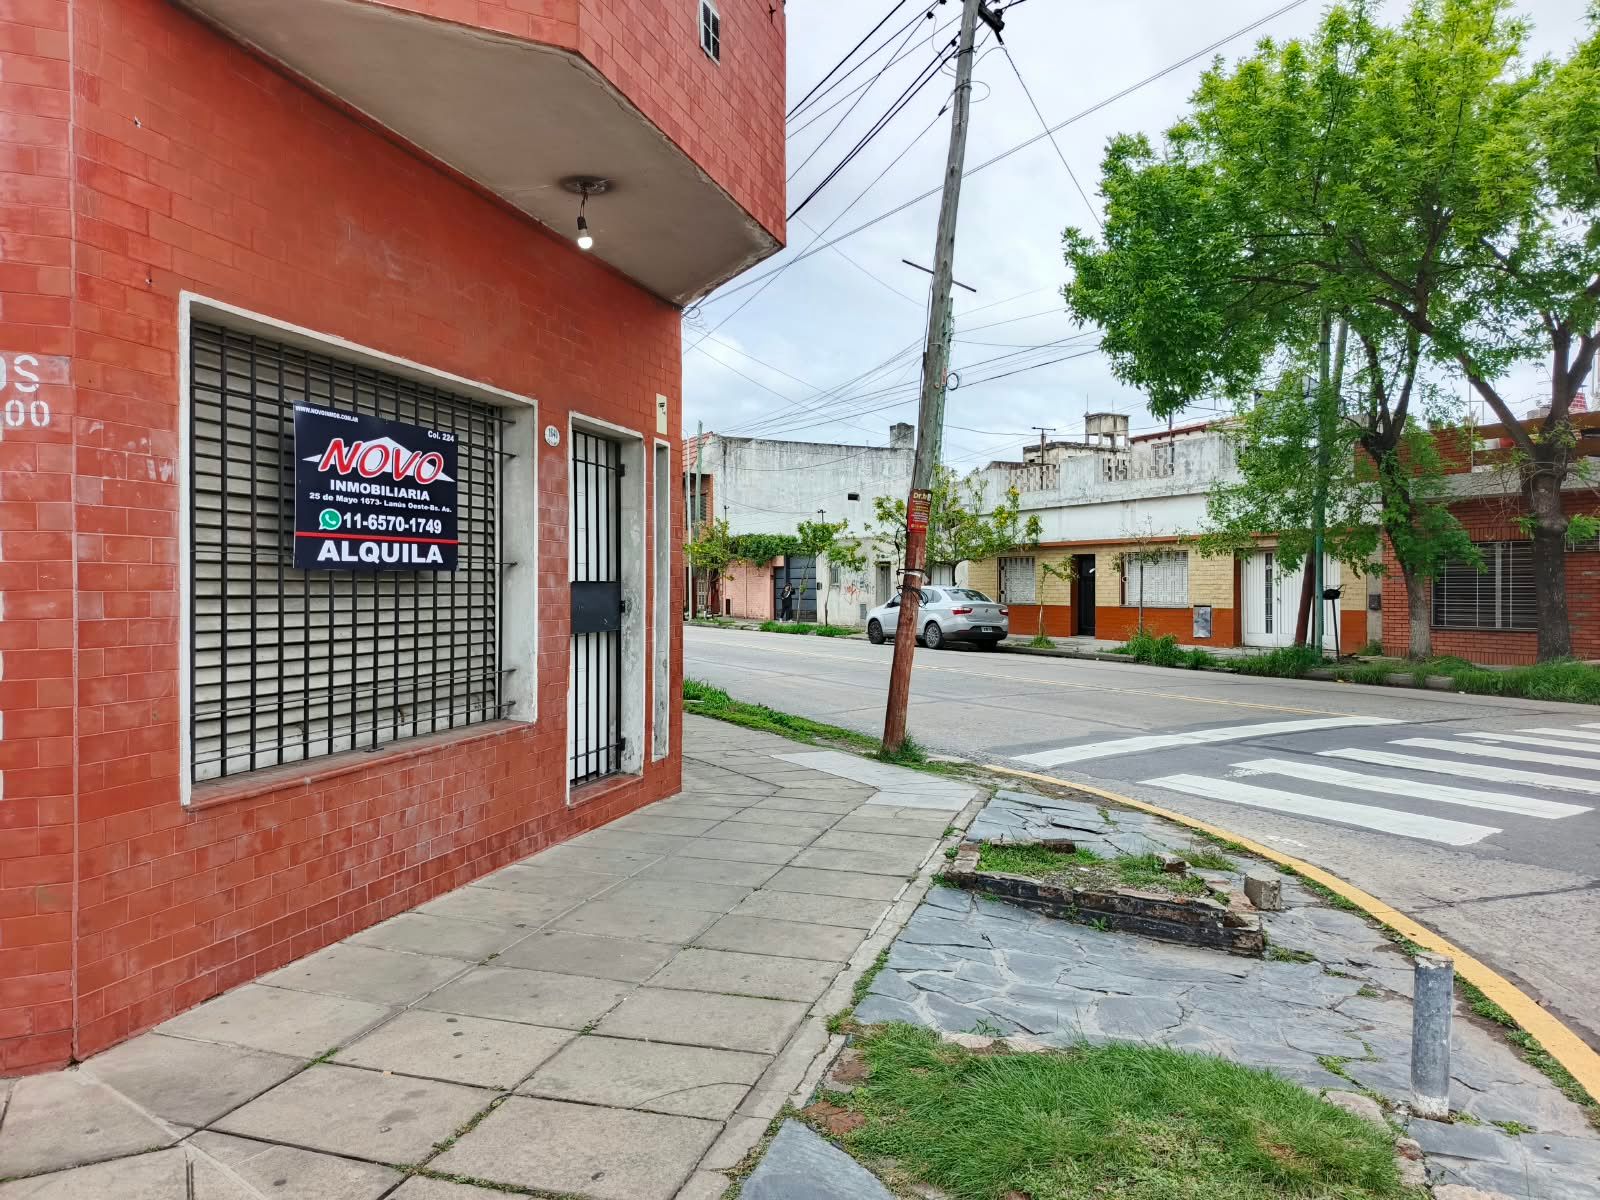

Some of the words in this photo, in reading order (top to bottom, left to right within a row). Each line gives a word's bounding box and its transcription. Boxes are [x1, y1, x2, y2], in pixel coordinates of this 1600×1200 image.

[0, 355, 39, 392] S
[427, 430, 441, 440] Col.
[442, 433, 455, 443] 224
[318, 438, 444, 485] NOVO
[309, 492, 321, 500] 25
[322, 493, 334, 501] de
[335, 495, 359, 504] Mayo
[383, 499, 406, 508] Lanús
[330, 479, 430, 501] INMOBILIARIA
[343, 512, 442, 534] 11-6570-1749
[316, 540, 444, 564] ALQUILA
